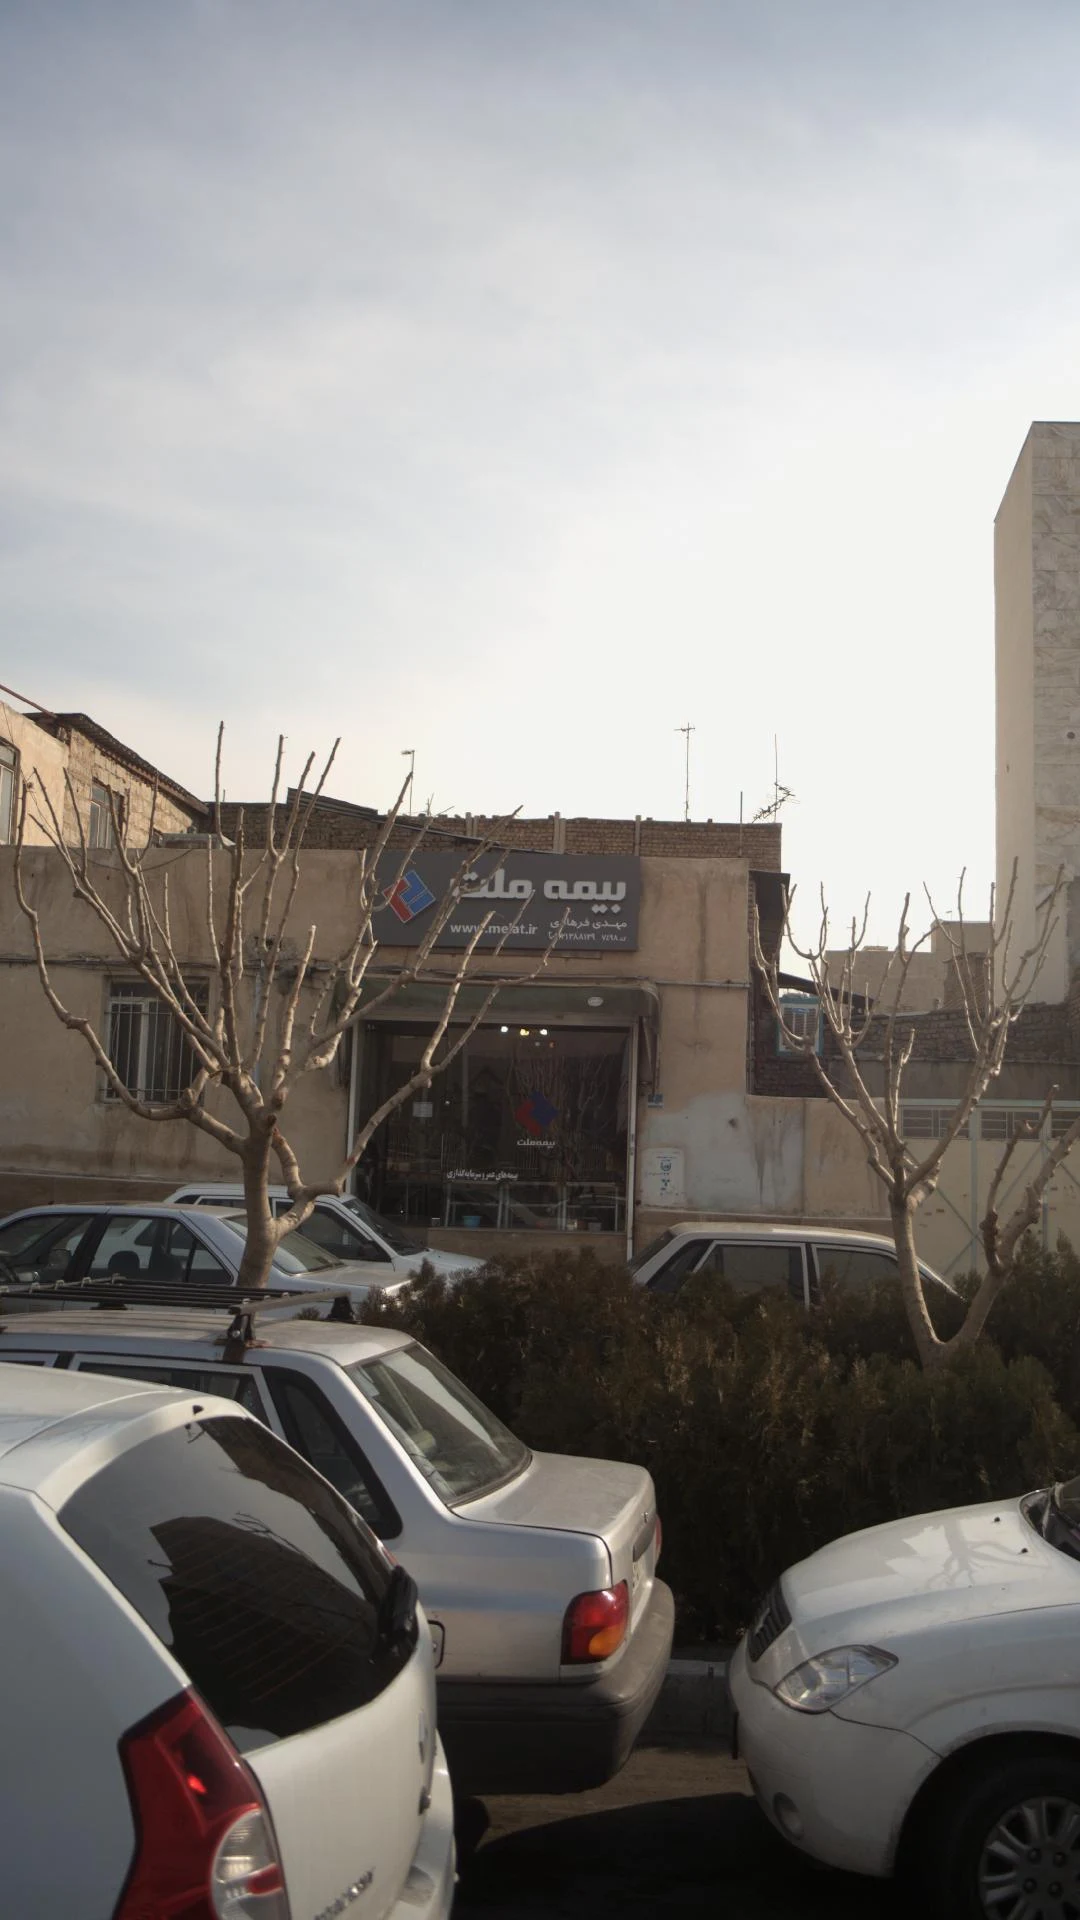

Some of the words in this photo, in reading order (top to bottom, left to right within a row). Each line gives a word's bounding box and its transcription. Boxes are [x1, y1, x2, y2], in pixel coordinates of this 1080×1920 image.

[450, 868, 533, 899] ملت
[543, 879, 627, 914] بیمه
[550, 917, 590, 929] فرهای
[592, 919, 628, 930] مهدی
